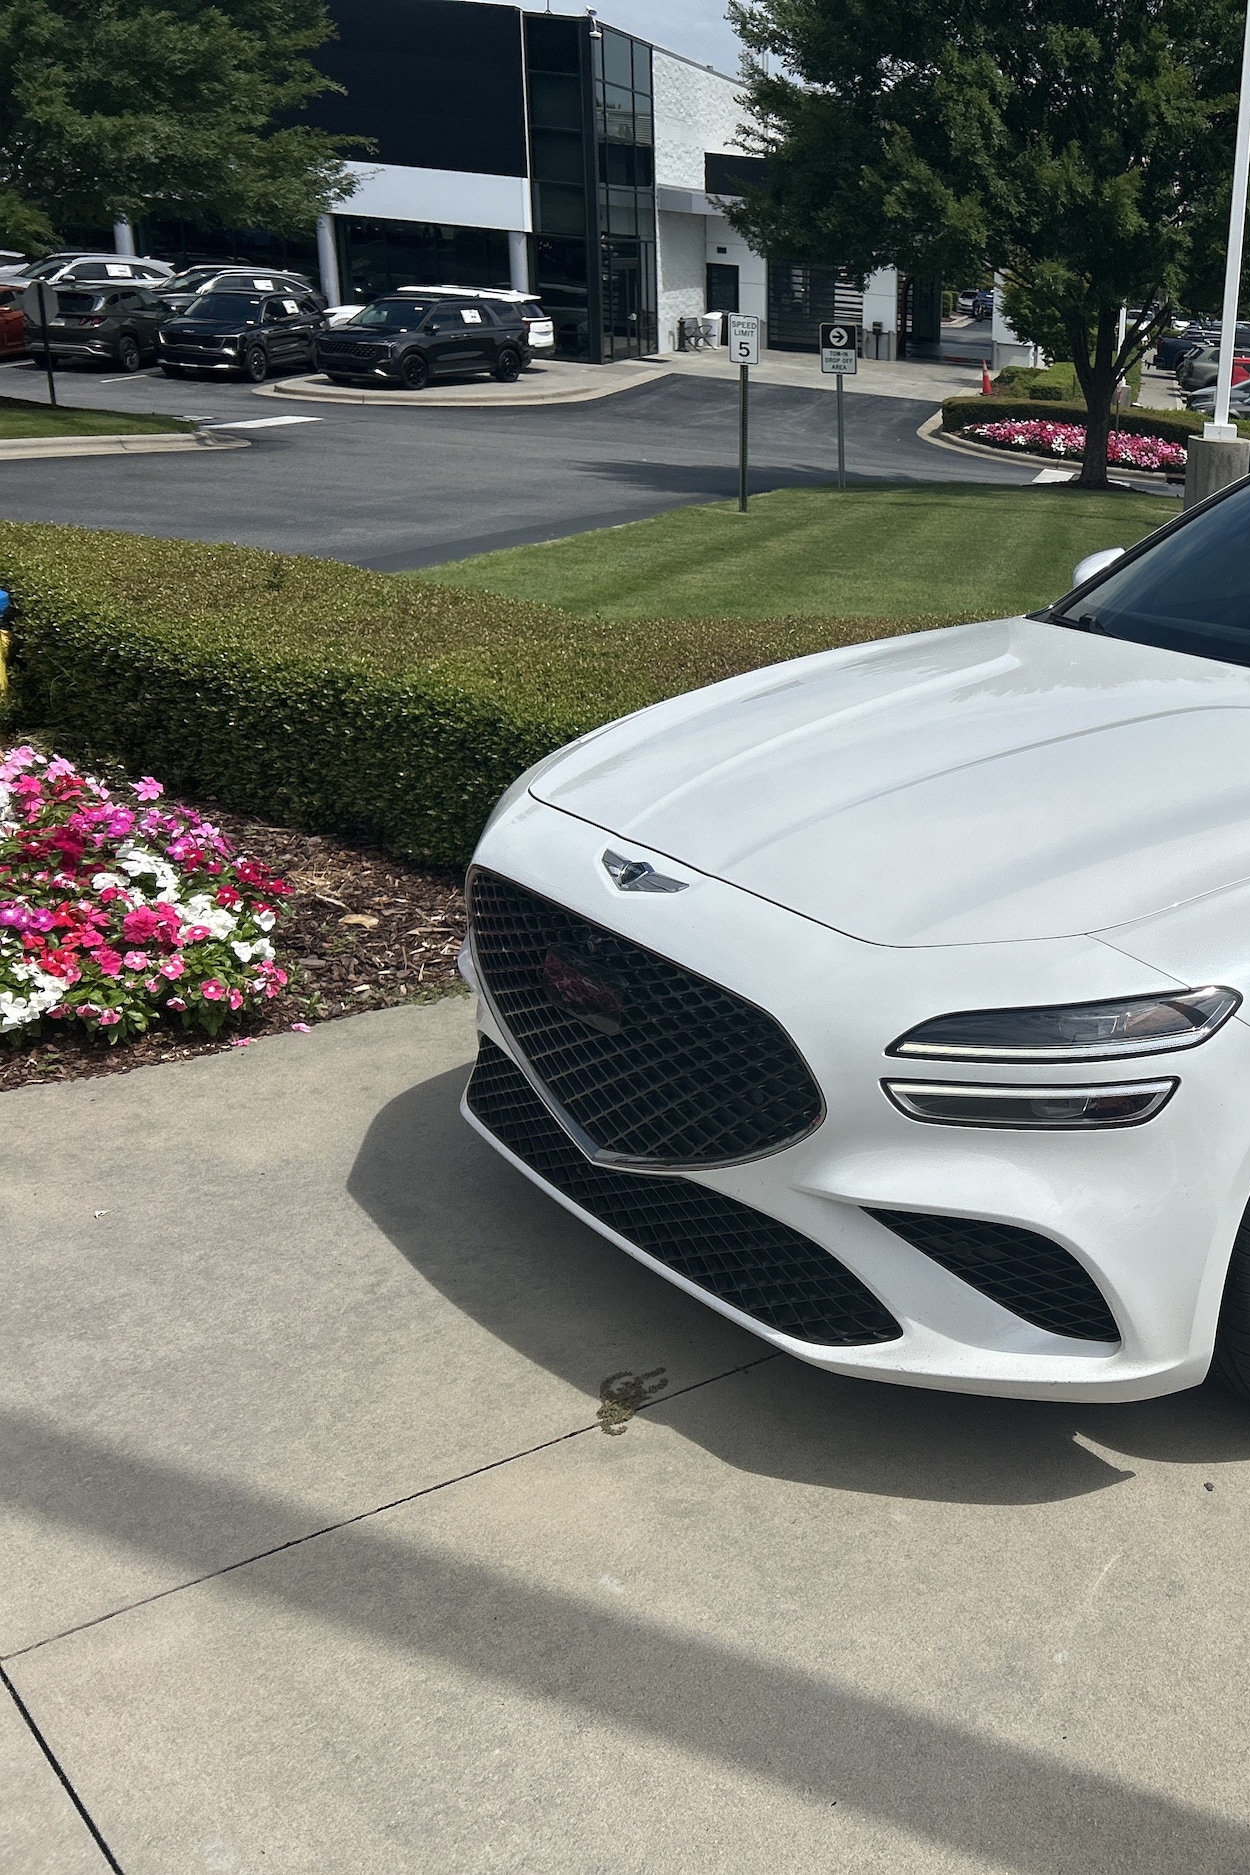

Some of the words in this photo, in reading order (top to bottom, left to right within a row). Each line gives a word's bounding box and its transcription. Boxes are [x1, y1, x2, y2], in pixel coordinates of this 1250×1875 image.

[731, 320, 757, 330] SPEED
[733, 329, 755, 338] LIMIT
[738, 341, 751, 357] 5
